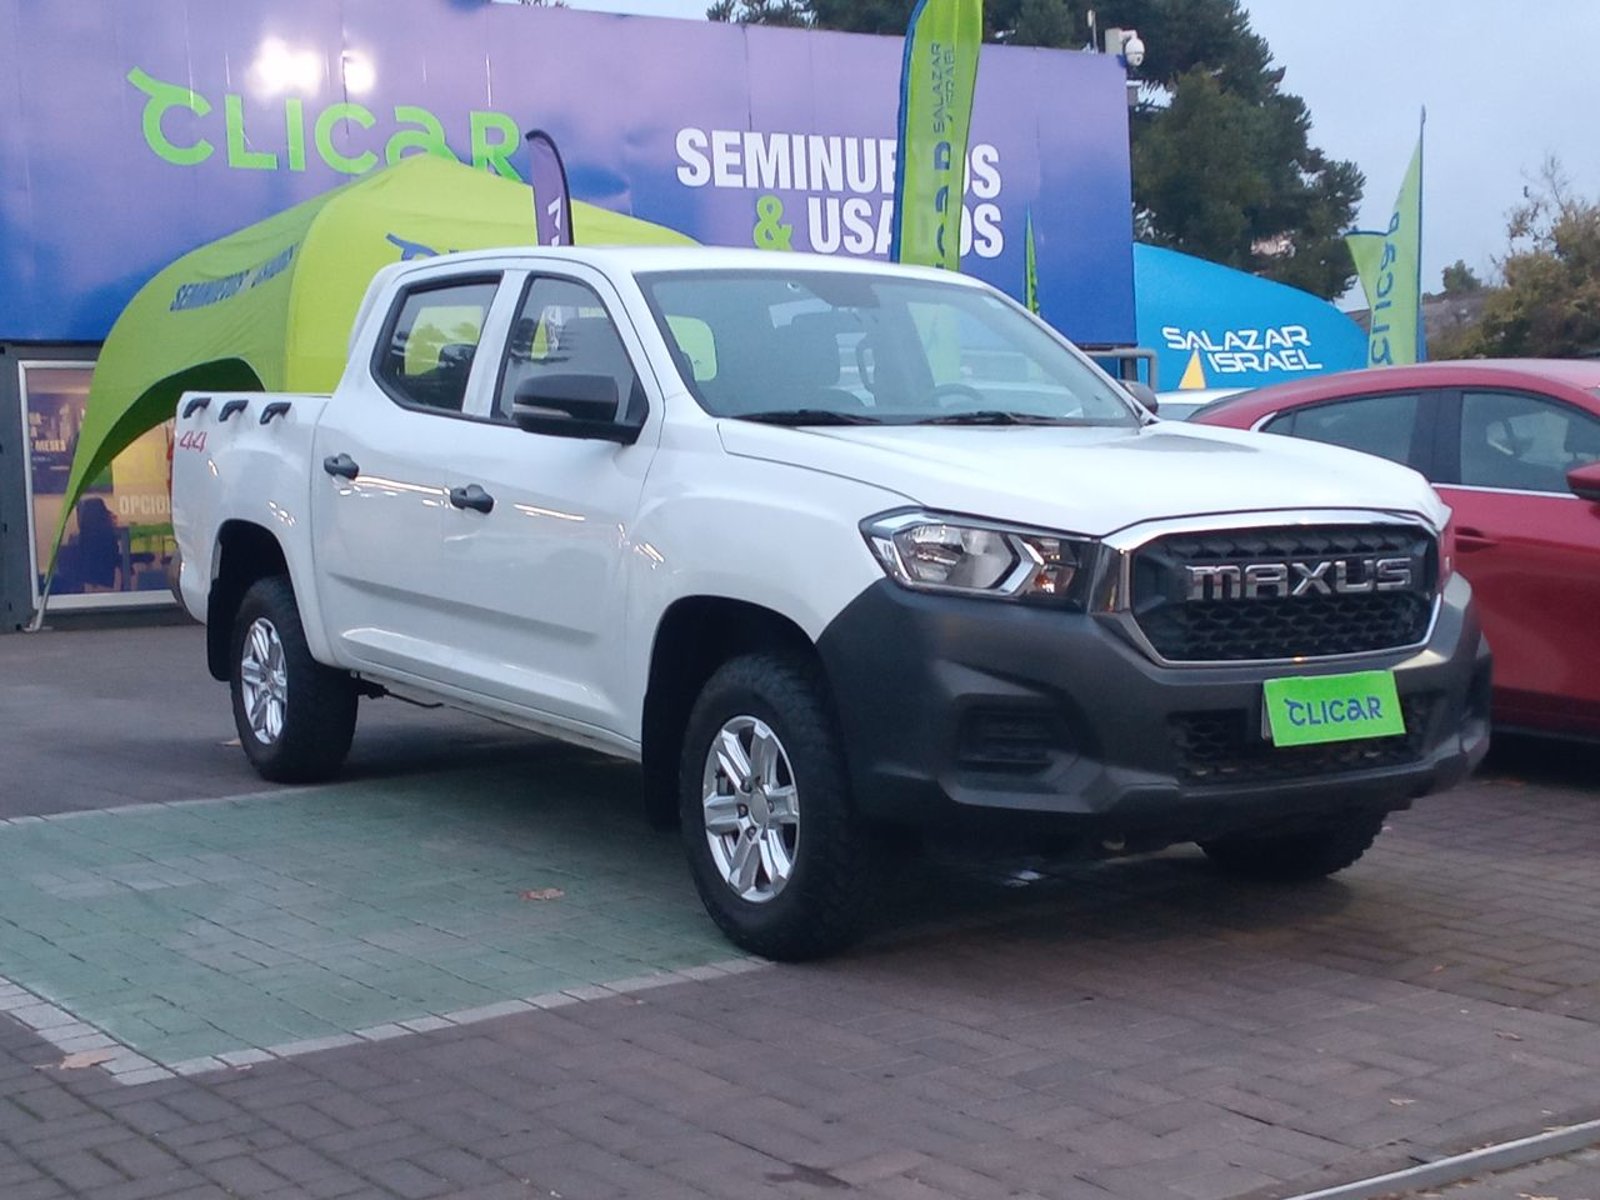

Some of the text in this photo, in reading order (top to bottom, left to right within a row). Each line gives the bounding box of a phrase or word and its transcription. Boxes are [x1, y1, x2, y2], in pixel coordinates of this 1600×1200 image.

[931, 43, 946, 133] SALAZAR
[675, 127, 1002, 199] SEMINUES
[753, 195, 793, 250] &
[1162, 325, 1311, 351] SALAZAR
[1207, 349, 1323, 373] ISRAEL
[1186, 557, 1412, 600] MAXUS
